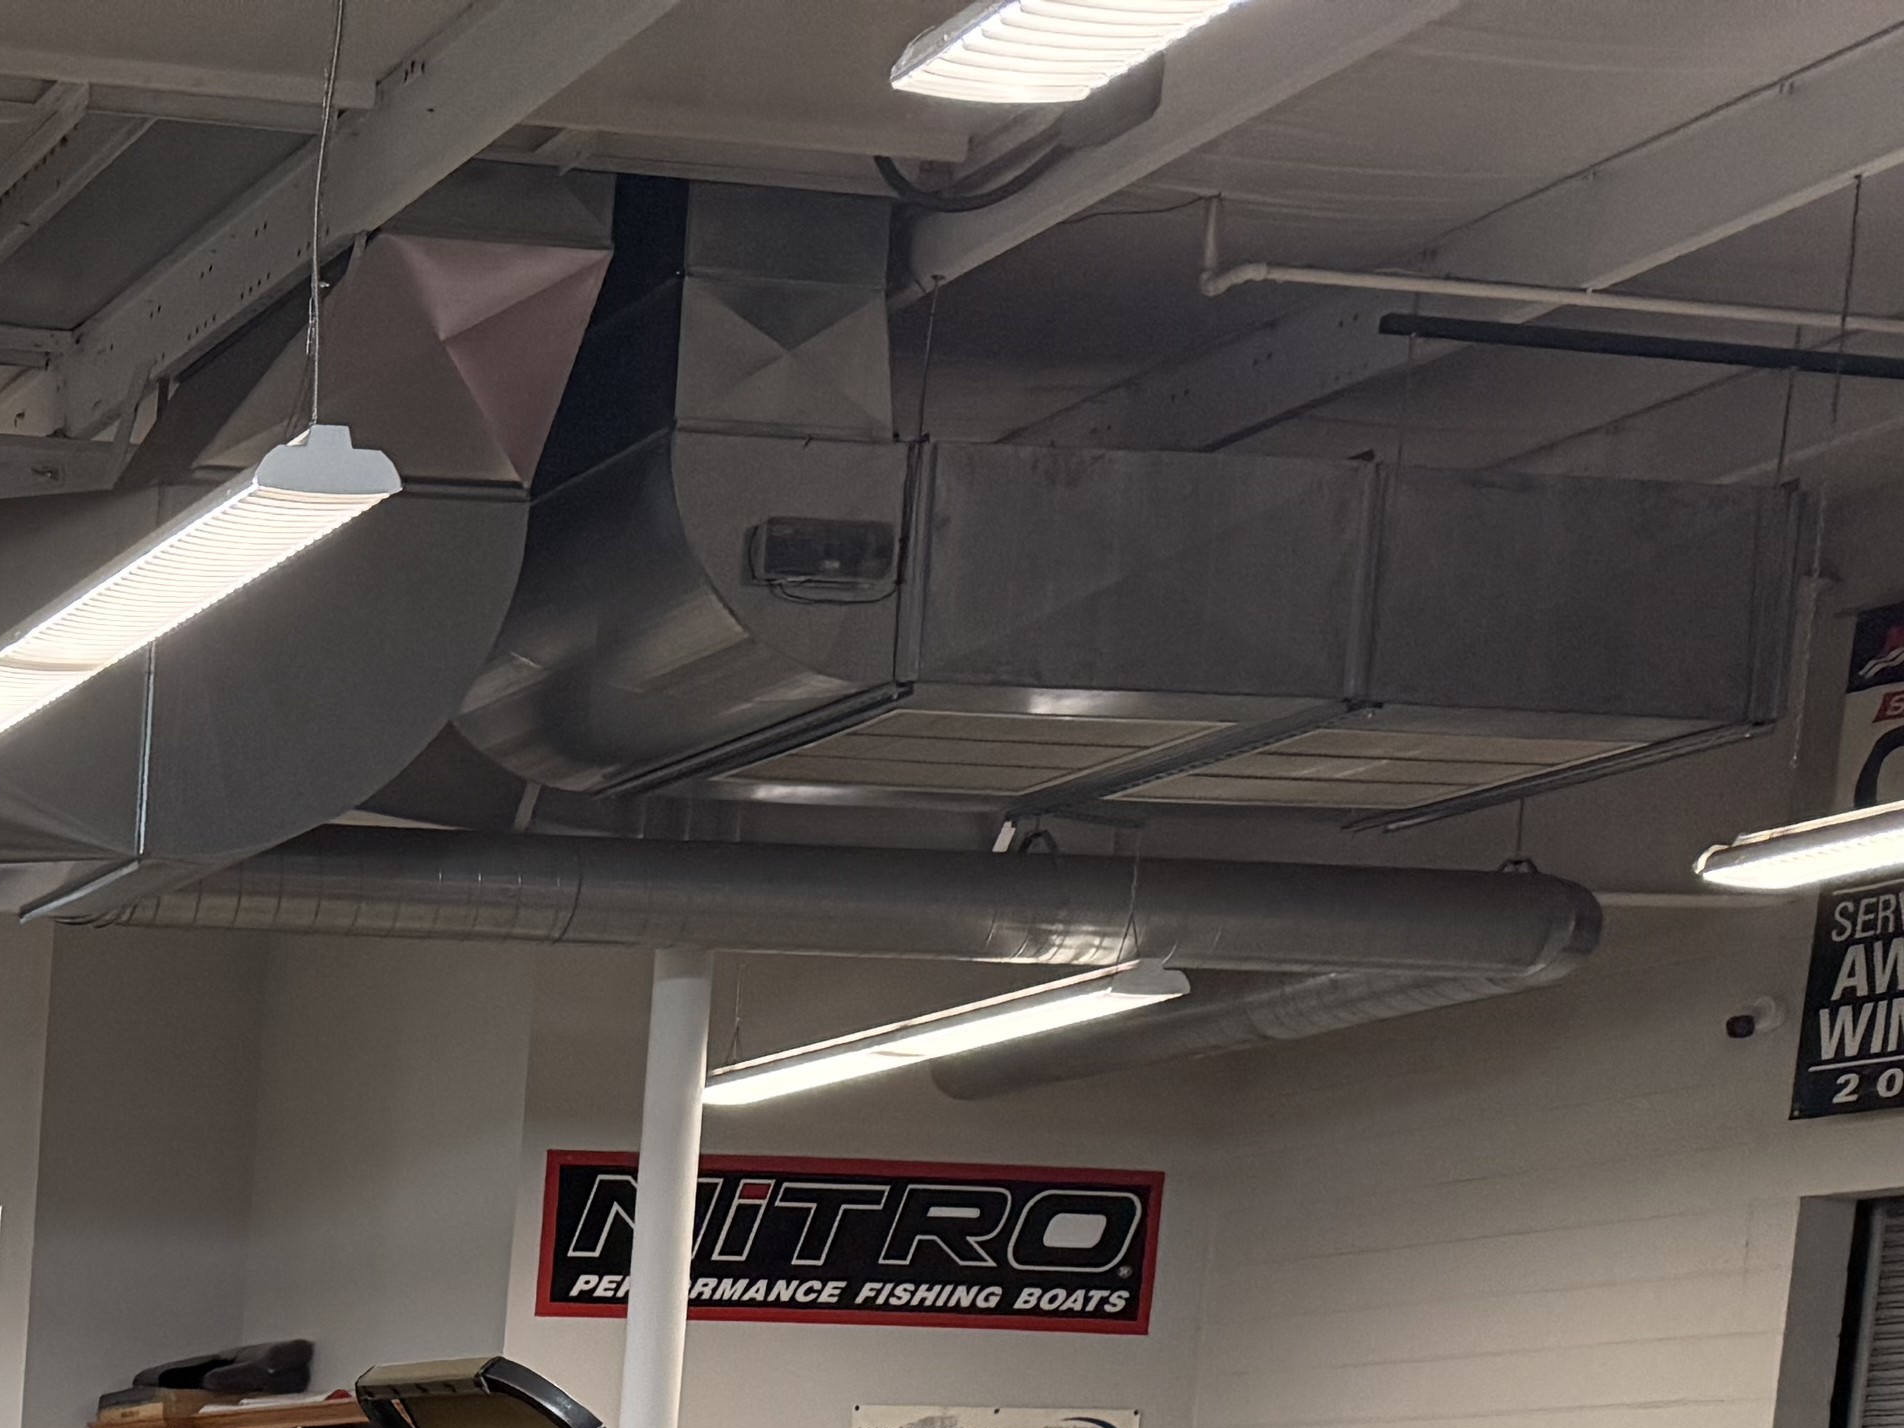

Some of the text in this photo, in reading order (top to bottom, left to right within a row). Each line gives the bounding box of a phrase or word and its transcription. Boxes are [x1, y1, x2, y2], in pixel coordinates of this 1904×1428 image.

[569, 1274, 1132, 1314] PERMANCE FISHING BOATS
